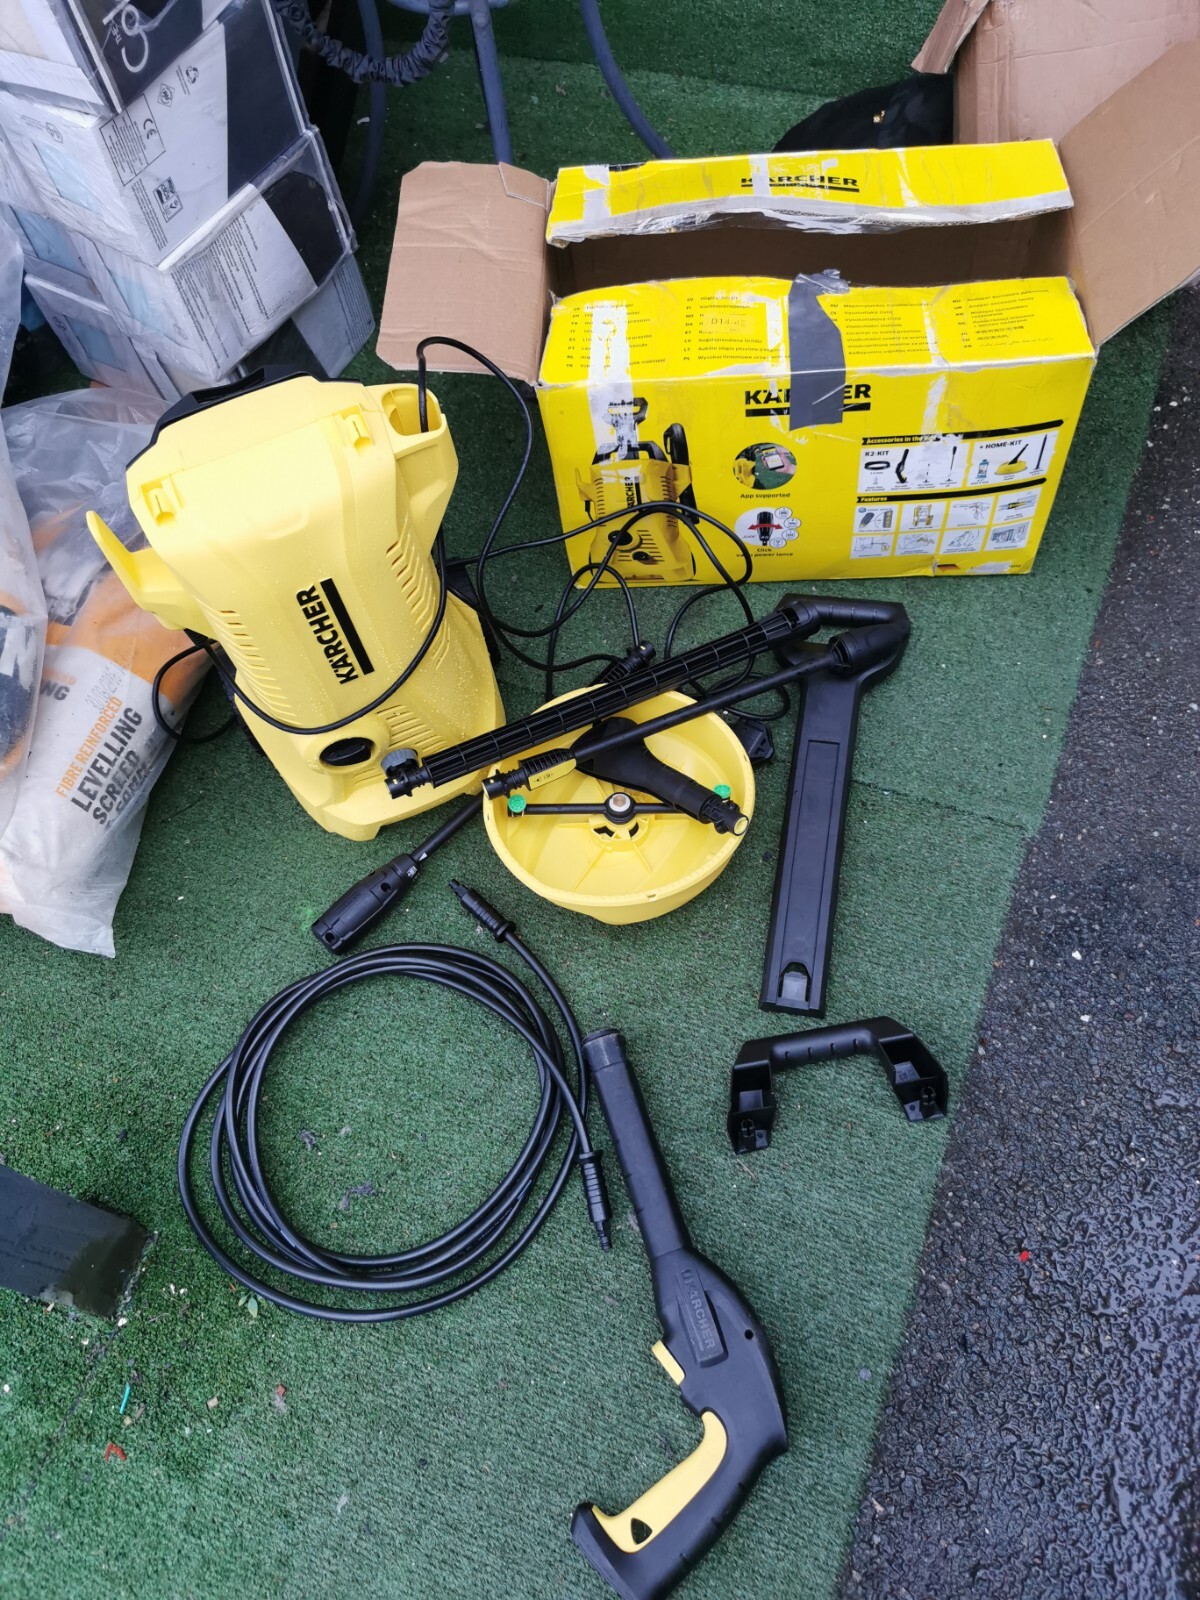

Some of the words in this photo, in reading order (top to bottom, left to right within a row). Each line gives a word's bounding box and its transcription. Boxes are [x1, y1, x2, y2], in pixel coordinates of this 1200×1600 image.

[296, 584, 359, 685] KÄRCHER
[55, 761, 83, 798] FIBRE
[74, 695, 124, 765] REINFORCED
[71, 707, 142, 812] LEVELLING
[92, 749, 140, 825] SCREED
